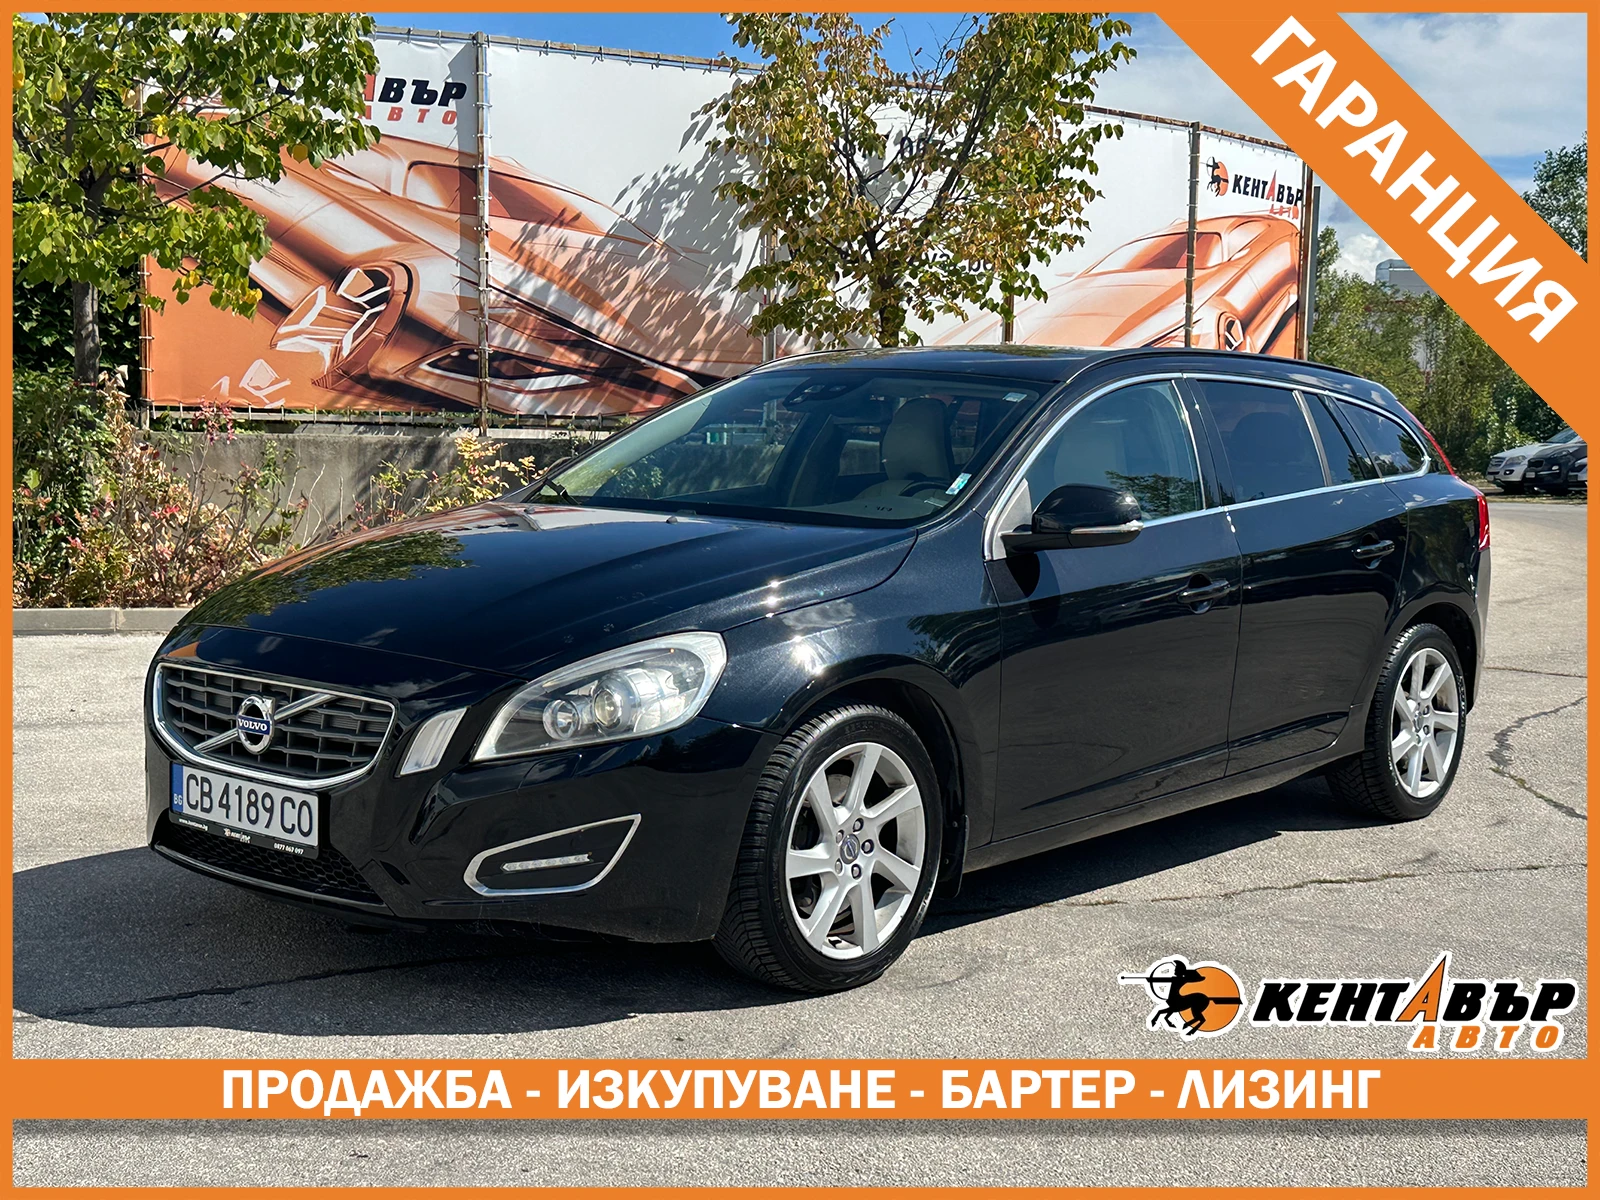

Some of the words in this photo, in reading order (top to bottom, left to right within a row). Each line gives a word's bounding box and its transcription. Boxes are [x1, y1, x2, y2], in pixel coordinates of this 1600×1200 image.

[1232, 169, 1303, 206] КЕНТАВЪР
[238, 718, 268, 732] VOLVO
[173, 793, 183, 806] BG
[218, 782, 274, 829] 4189
